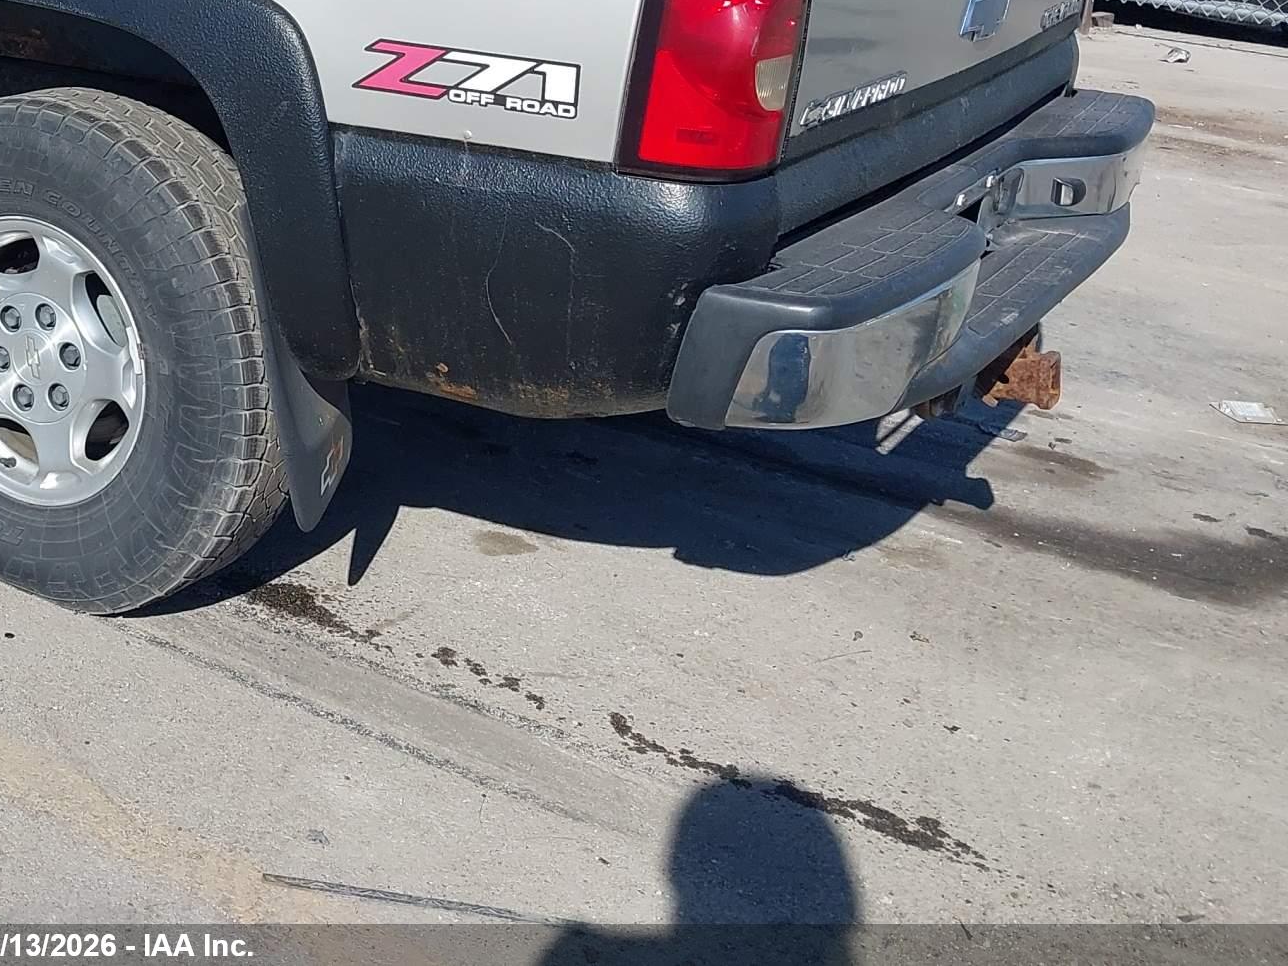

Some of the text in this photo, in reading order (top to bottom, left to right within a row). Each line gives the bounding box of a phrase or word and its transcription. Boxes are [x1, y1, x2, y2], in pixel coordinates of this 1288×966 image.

[352, 38, 581, 104] Z71
[448, 89, 577, 119] OFF ROAD
